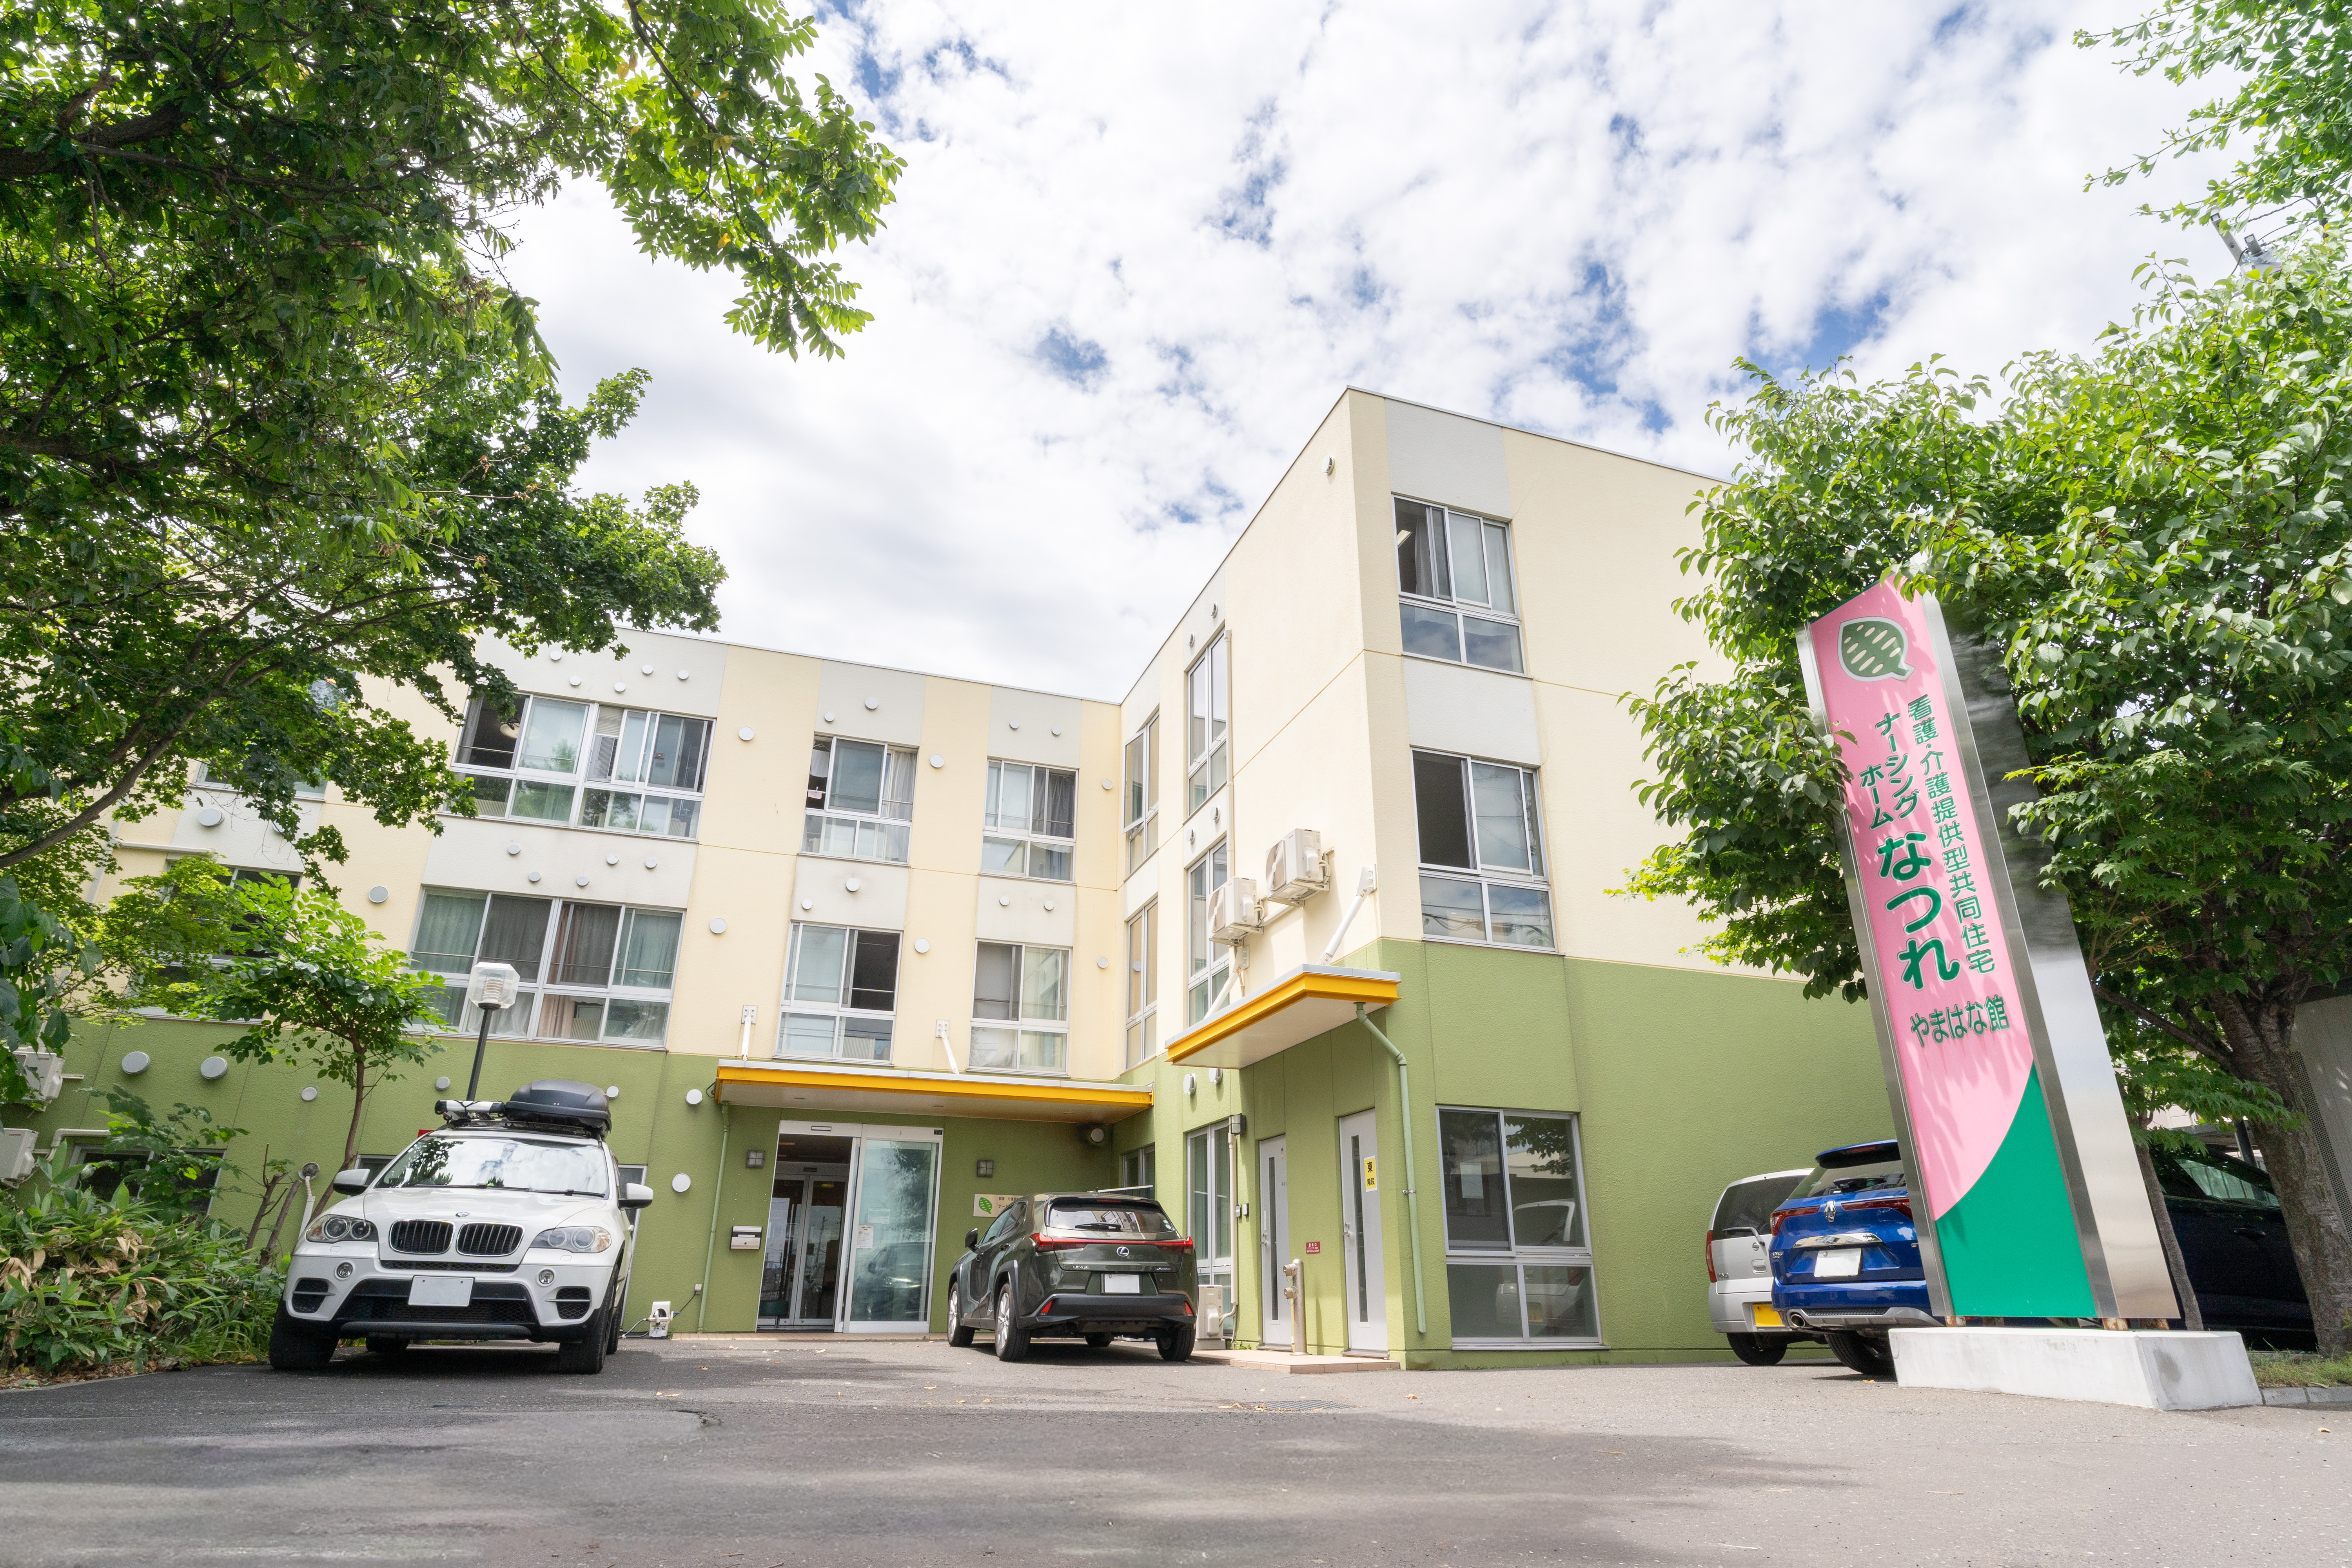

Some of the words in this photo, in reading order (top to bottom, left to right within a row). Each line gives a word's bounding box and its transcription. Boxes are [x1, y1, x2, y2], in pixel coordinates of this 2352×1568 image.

[1859, 765, 1894, 829] ホーム
[1876, 713, 1919, 818] ナーシング
[1909, 695, 1995, 974] 看護・介護提供型共同住宅
[1877, 833, 1960, 990] なつれ
[1911, 995, 2009, 1047] やまはな館
[1367, 1161, 1373, 1173] 東
[1367, 1177, 1375, 1186] 階段
